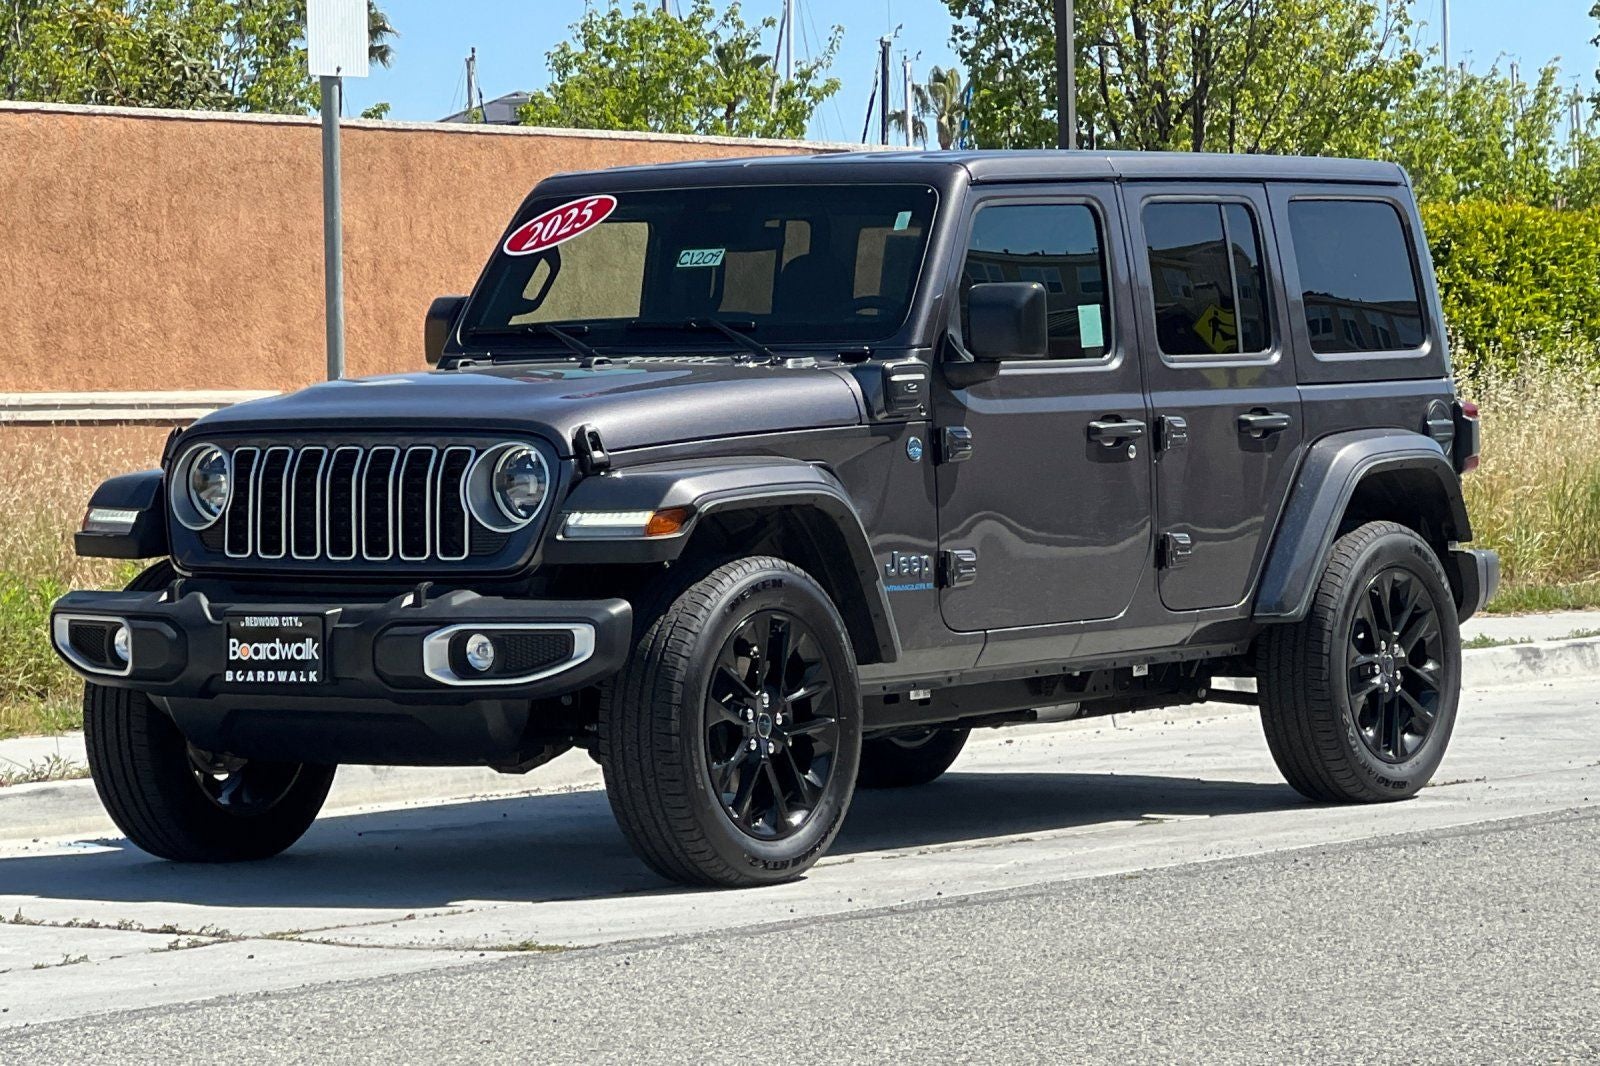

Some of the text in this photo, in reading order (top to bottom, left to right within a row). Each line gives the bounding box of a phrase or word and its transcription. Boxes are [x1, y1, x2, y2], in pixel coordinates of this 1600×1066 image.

[520, 199, 599, 250] 2025
[885, 551, 931, 577] Jeep
[245, 616, 299, 627] REDWOOD CITY
[229, 637, 319, 660] Boardwalk
